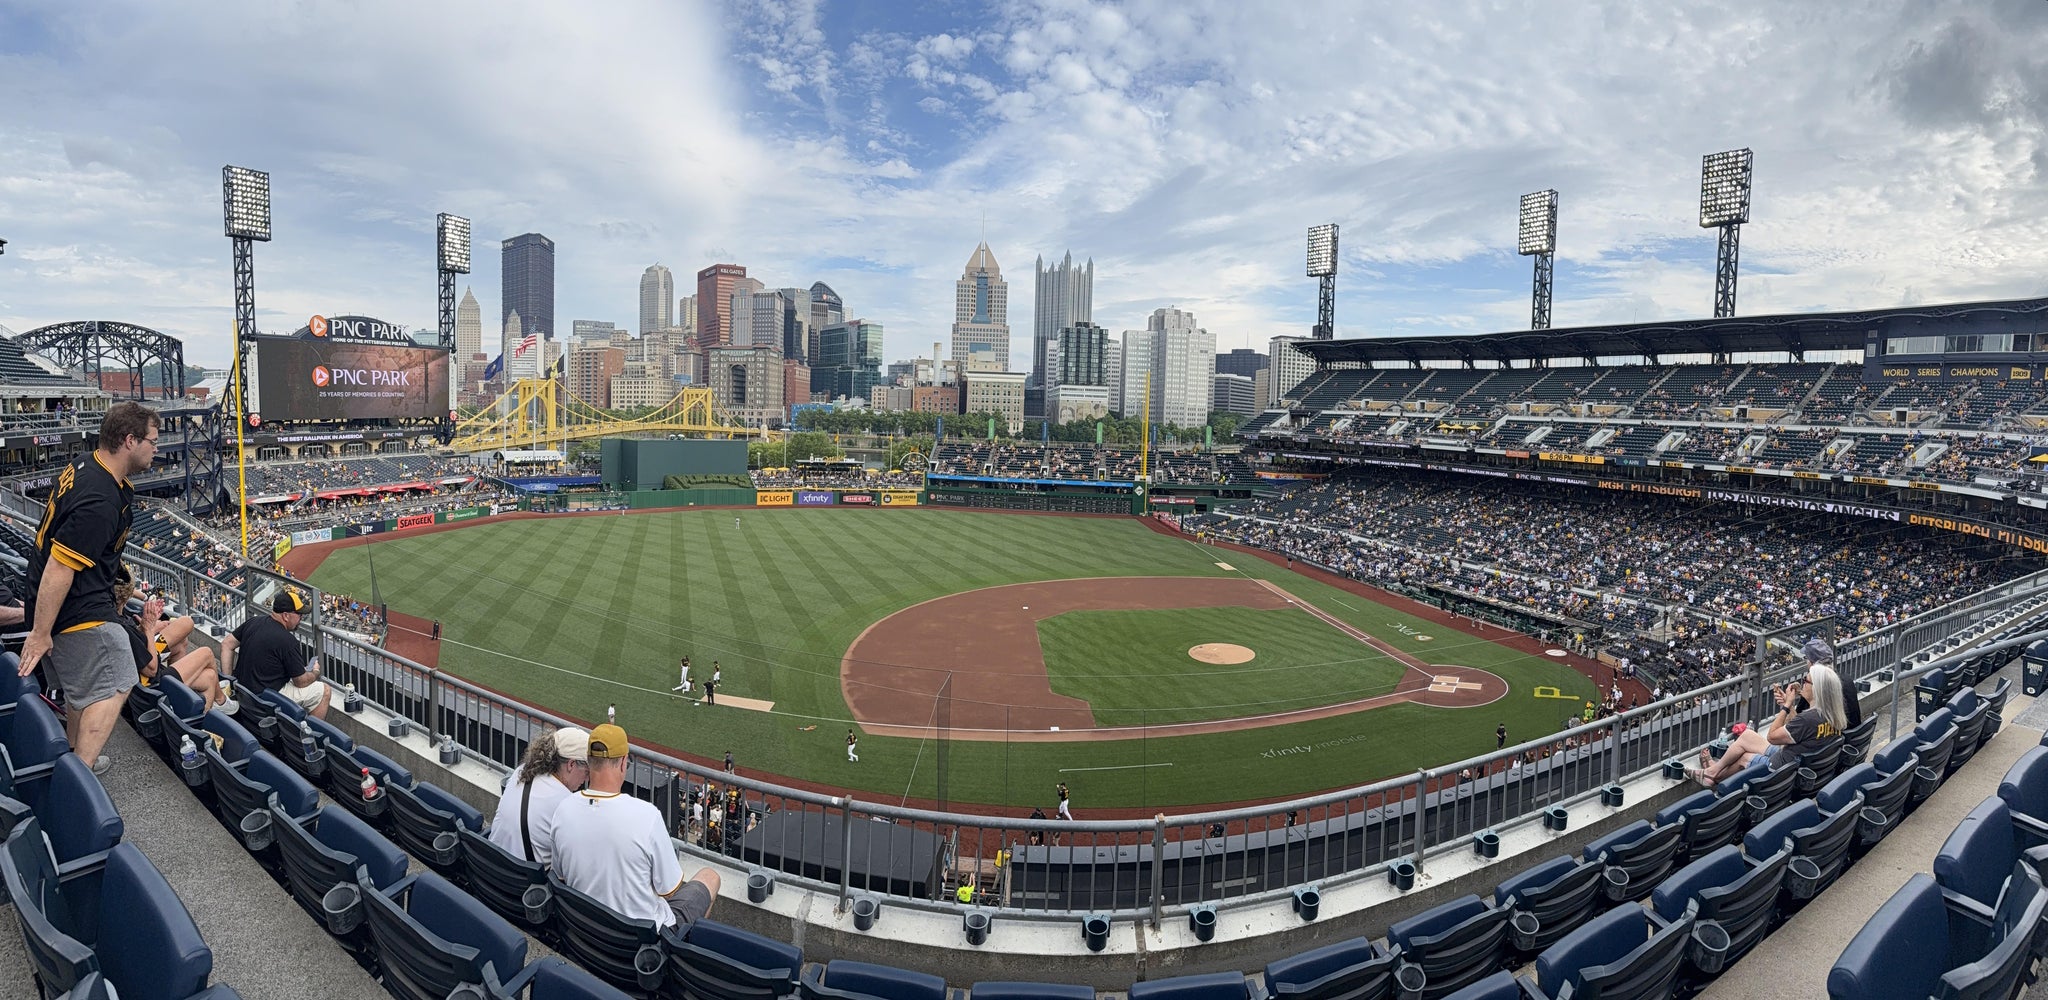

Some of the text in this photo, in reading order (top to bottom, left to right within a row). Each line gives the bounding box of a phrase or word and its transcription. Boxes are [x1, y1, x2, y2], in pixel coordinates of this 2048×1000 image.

[330, 319, 410, 341] PNC PARK
[331, 368, 410, 386] PNC PARK
[1883, 368, 1999, 377] WORLD SERIES CHAMPIONS
[39, 435, 50, 443] PNC
[24, 477, 53, 490] PNC PARK
[803, 493, 829, 503] xfinity
[399, 515, 433, 529] SEATGEEK
[1260, 734, 1367, 759] xfinity mobile
